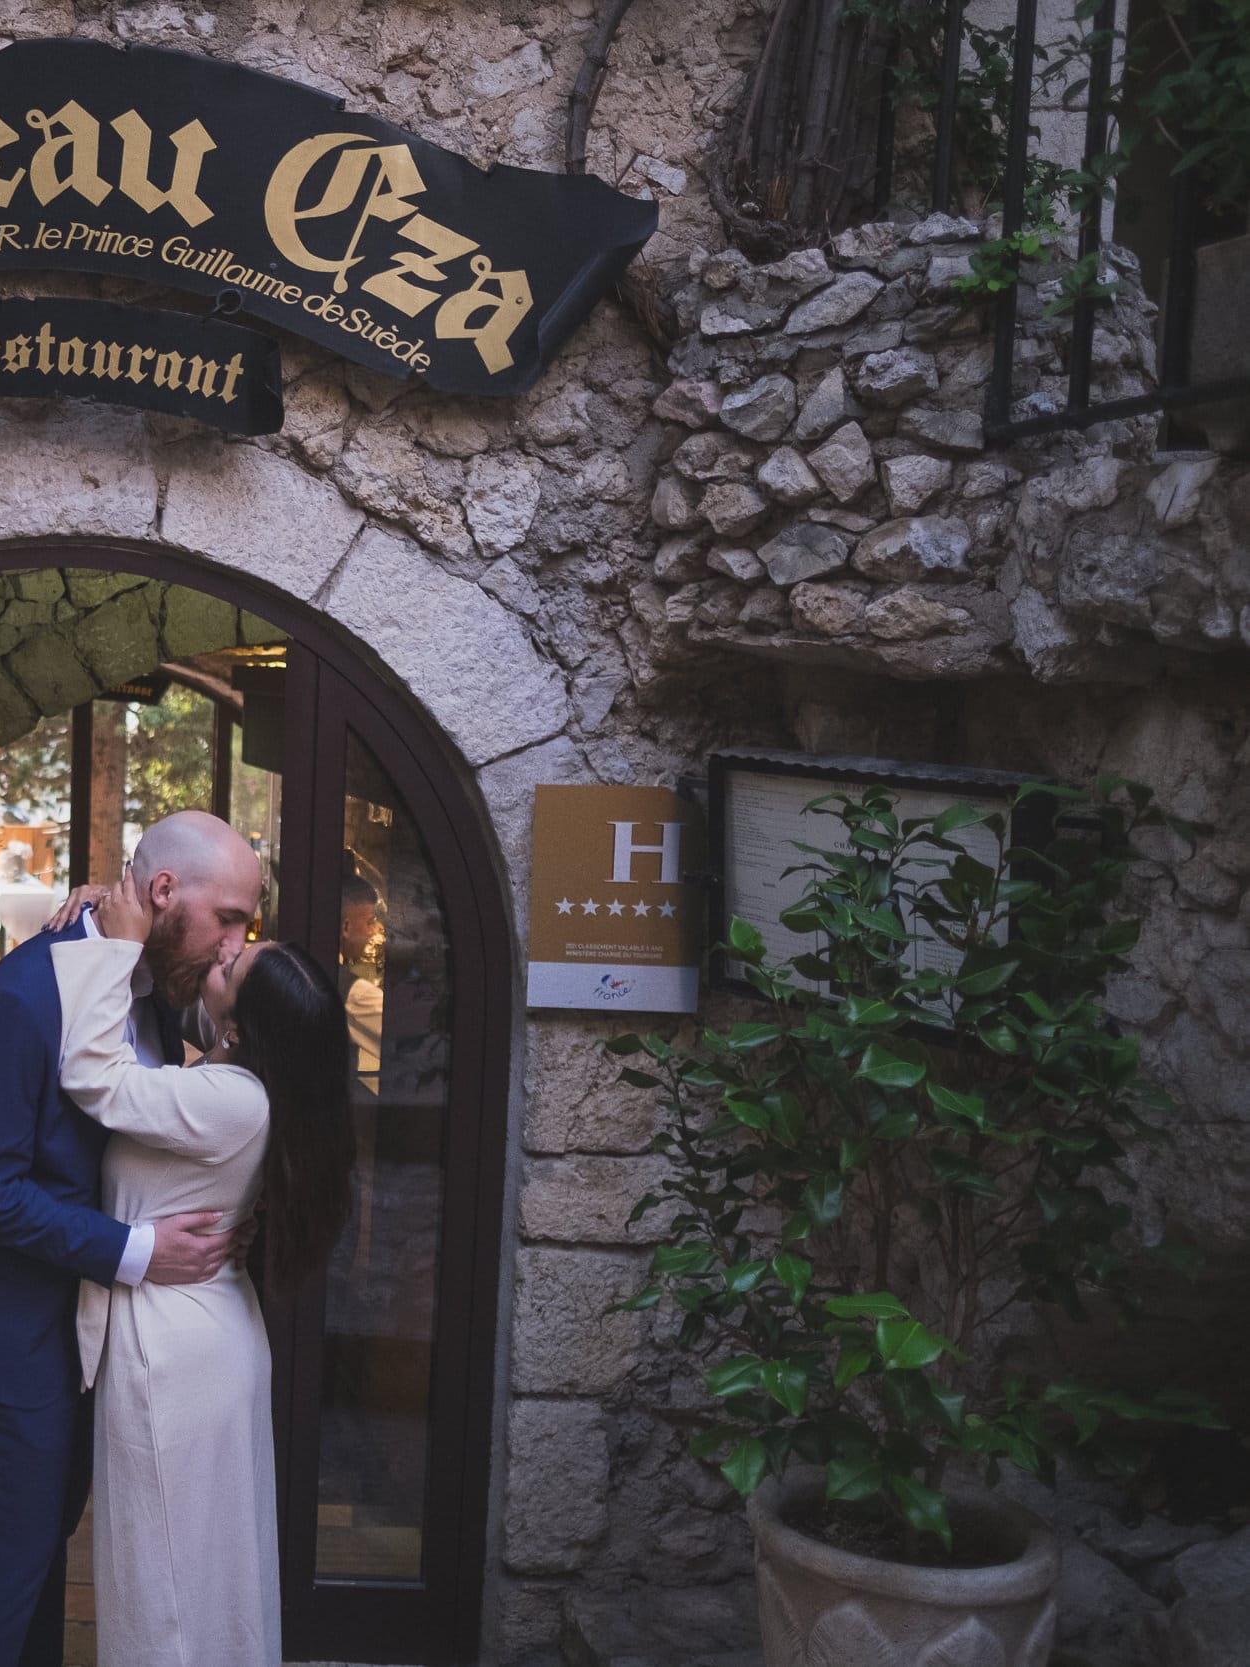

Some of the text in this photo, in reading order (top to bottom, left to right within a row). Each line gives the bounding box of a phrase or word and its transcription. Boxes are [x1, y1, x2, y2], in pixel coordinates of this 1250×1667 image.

[33, 222, 62, 249] le
[63, 222, 154, 257] Prince
[160, 235, 302, 305] Guillaume
[302, 294, 343, 323] de
[264, 132, 534, 375] Eza
[604, 820, 685, 884] H
